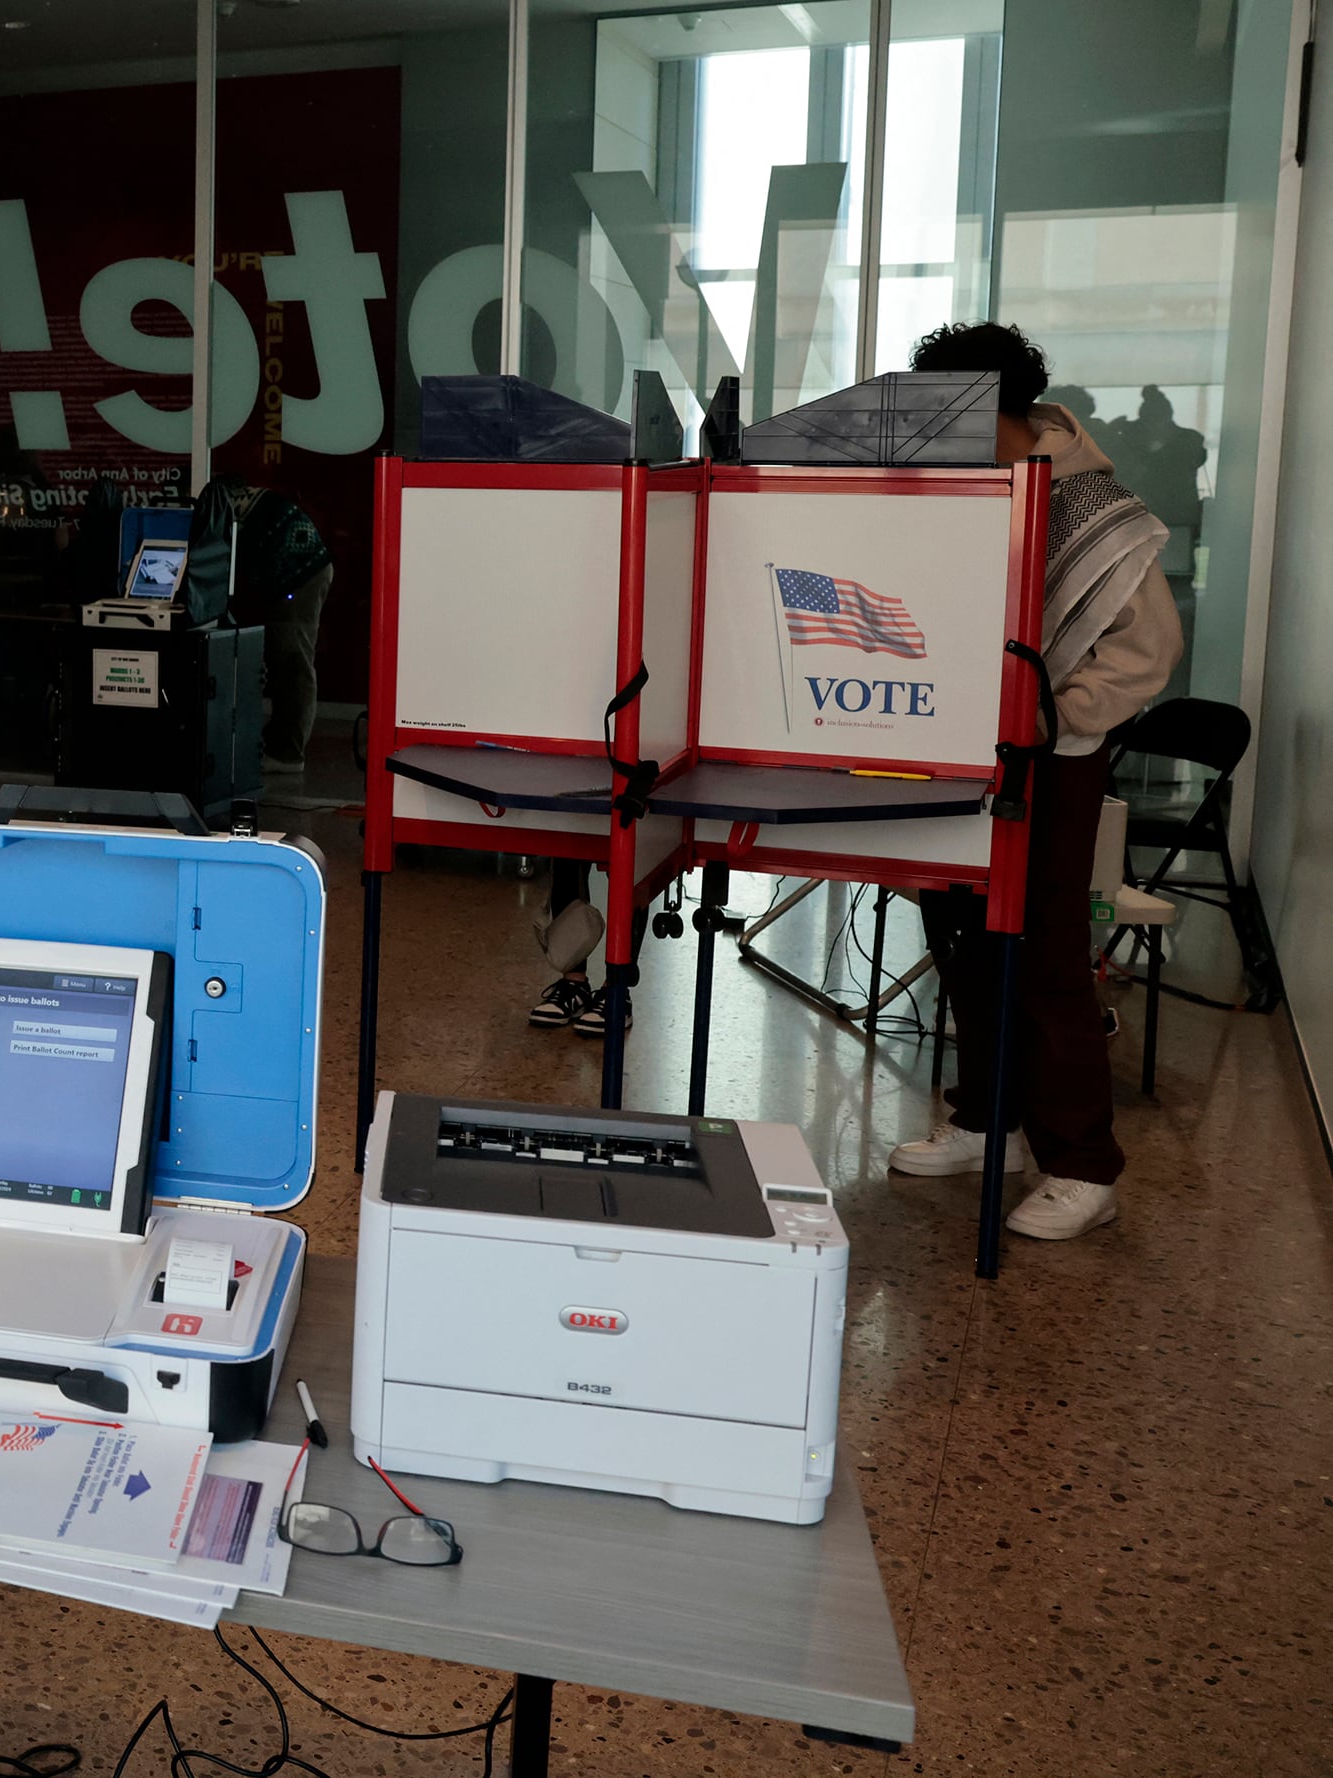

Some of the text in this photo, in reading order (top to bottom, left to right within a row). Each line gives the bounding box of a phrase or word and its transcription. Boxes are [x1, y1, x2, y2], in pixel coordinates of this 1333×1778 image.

[805, 675, 936, 718] VOTE
[8, 995, 29, 1004] issue
[31, 996, 60, 1007] ballots
[16, 1024, 34, 1034] Issue
[41, 1027, 61, 1035] ballot
[13, 1044, 99, 1059] Print Ballot Count report
[568, 1313, 618, 1330] OKI
[567, 1381, 612, 1396] B432
